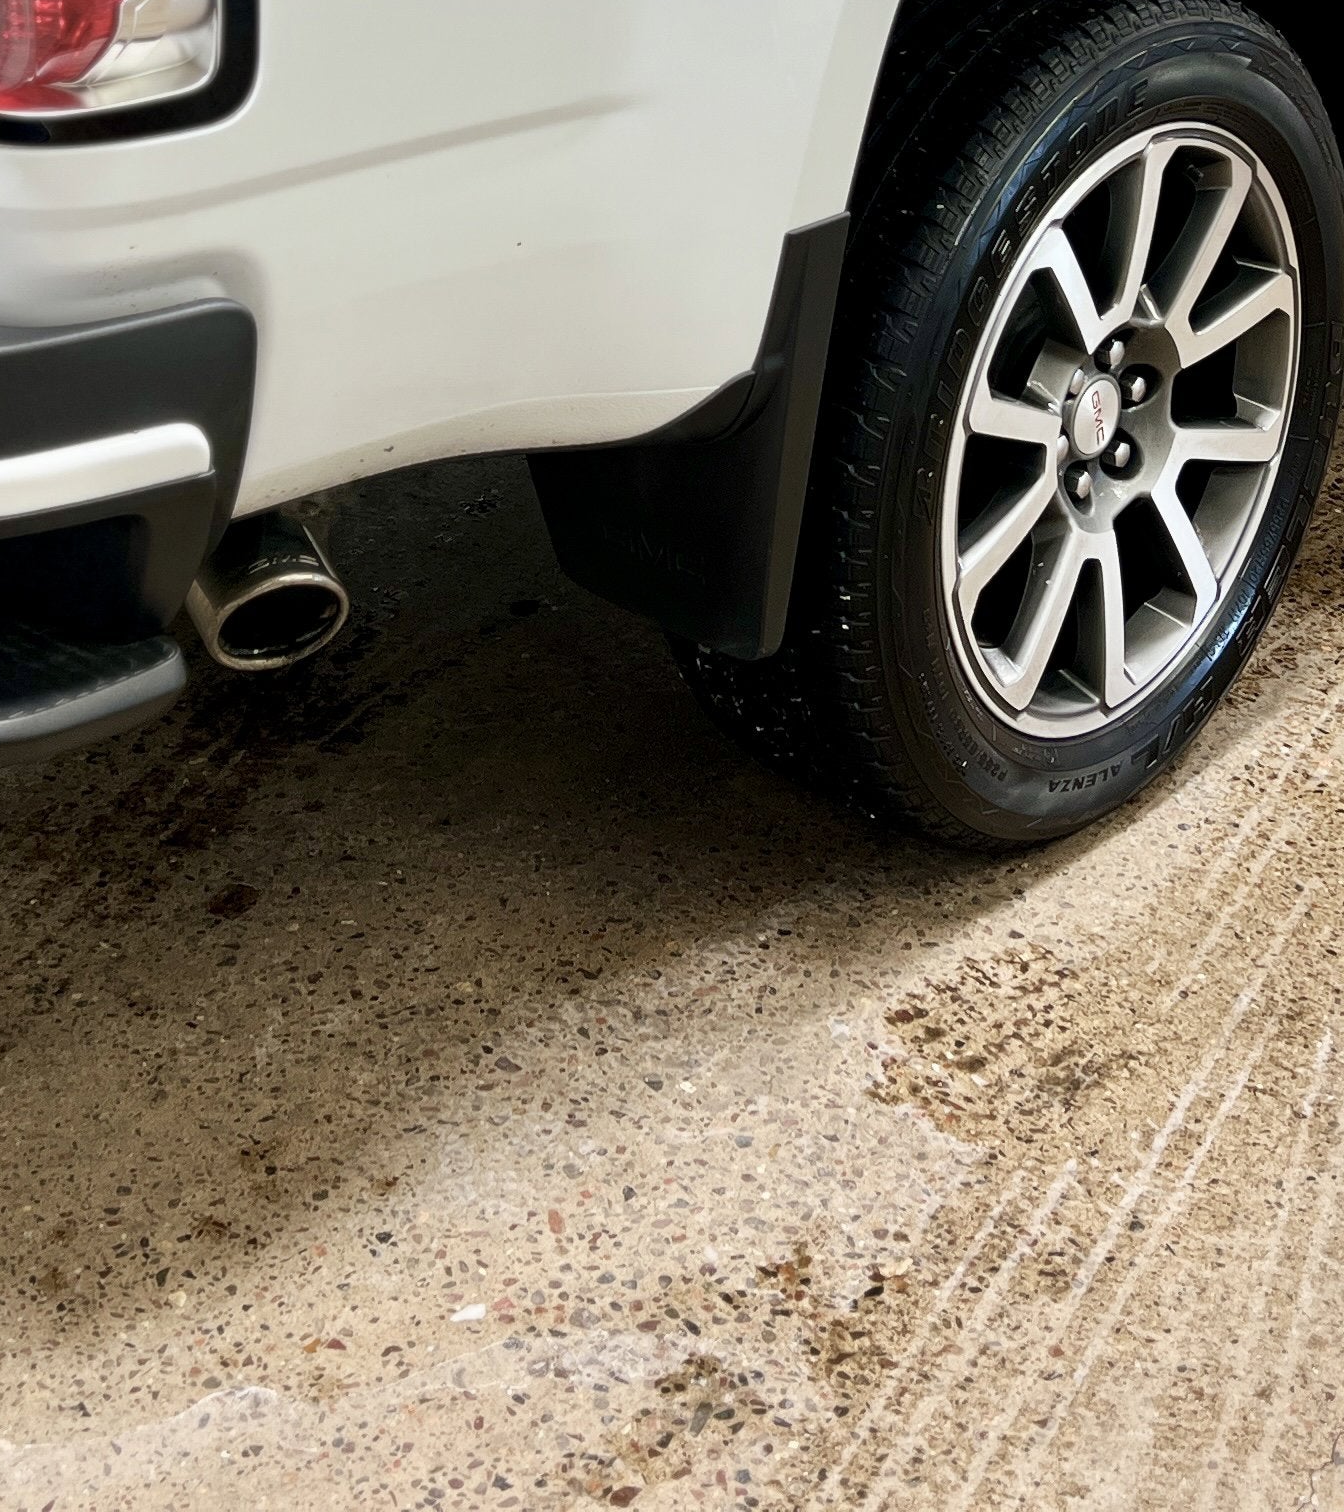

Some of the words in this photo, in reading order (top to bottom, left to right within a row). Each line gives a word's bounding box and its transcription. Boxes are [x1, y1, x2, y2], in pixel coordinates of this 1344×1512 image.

[913, 76, 1151, 528] BRIDGESTONE
[1092, 390, 1105, 446] GMC
[1048, 762, 1124, 793] ALENZA
